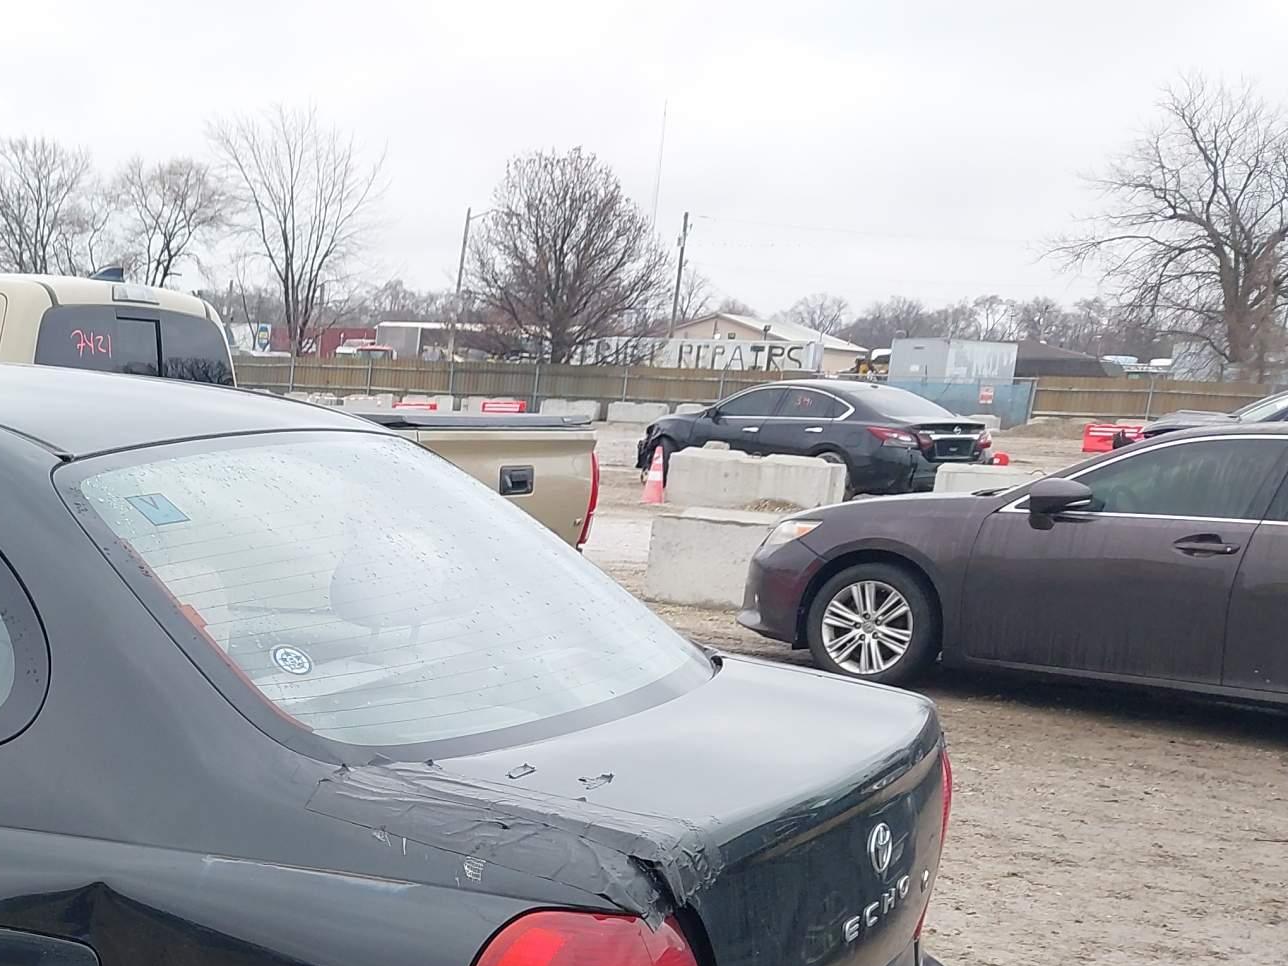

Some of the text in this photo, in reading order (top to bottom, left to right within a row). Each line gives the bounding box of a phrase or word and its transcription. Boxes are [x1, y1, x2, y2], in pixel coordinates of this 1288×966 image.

[71, 329, 112, 358] 7421
[677, 344, 803, 371] REPAIRS
[842, 875, 910, 943] ECHO
